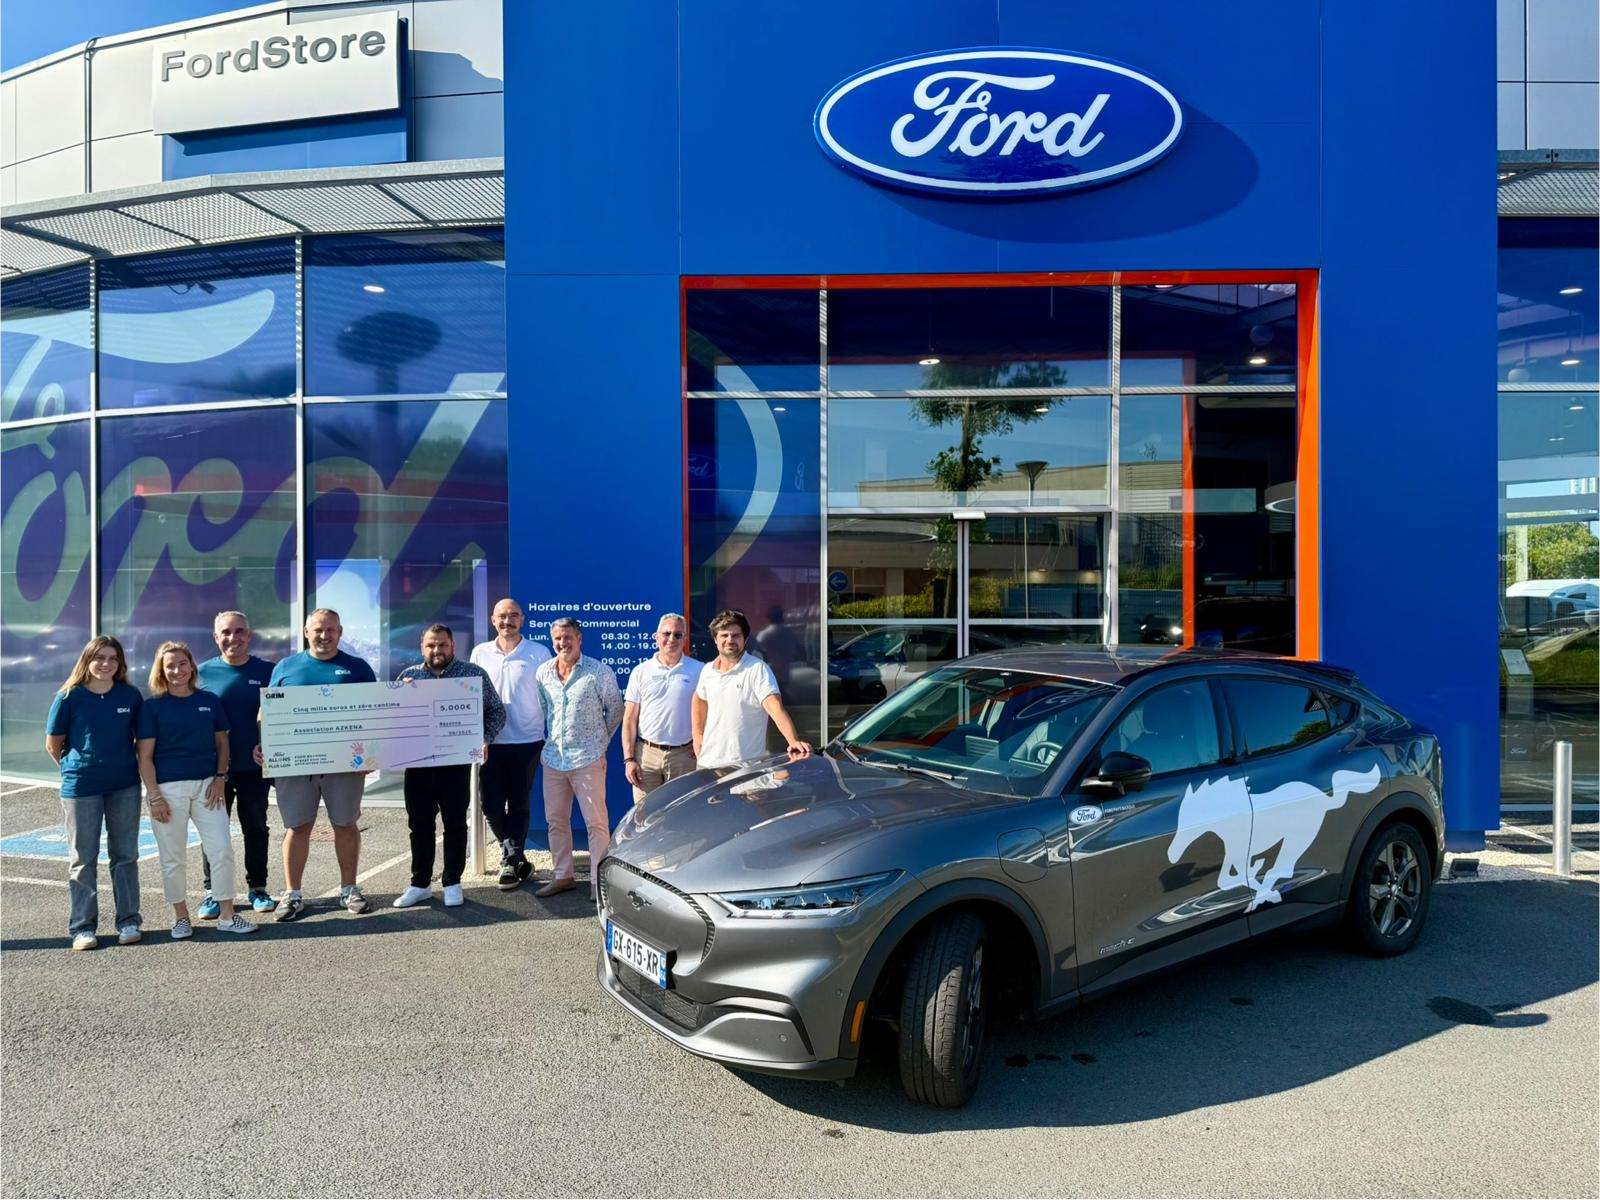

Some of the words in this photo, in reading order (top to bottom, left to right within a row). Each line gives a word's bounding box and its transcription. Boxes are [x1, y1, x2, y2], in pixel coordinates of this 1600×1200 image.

[161, 30, 386, 82] FordStore
[890, 70, 1111, 158] Ford
[528, 602, 580, 611] Horaires
[582, 602, 652, 611] d'ouverture
[529, 620, 554, 628] Serv
[529, 633, 549, 641] Lun.
[638, 642, 659, 650] 19.0
[601, 657, 631, 665] 09.00
[293, 726, 334, 734] Association
[1076, 808, 1097, 822] Ford
[613, 929, 659, 976] GX-615-XR
